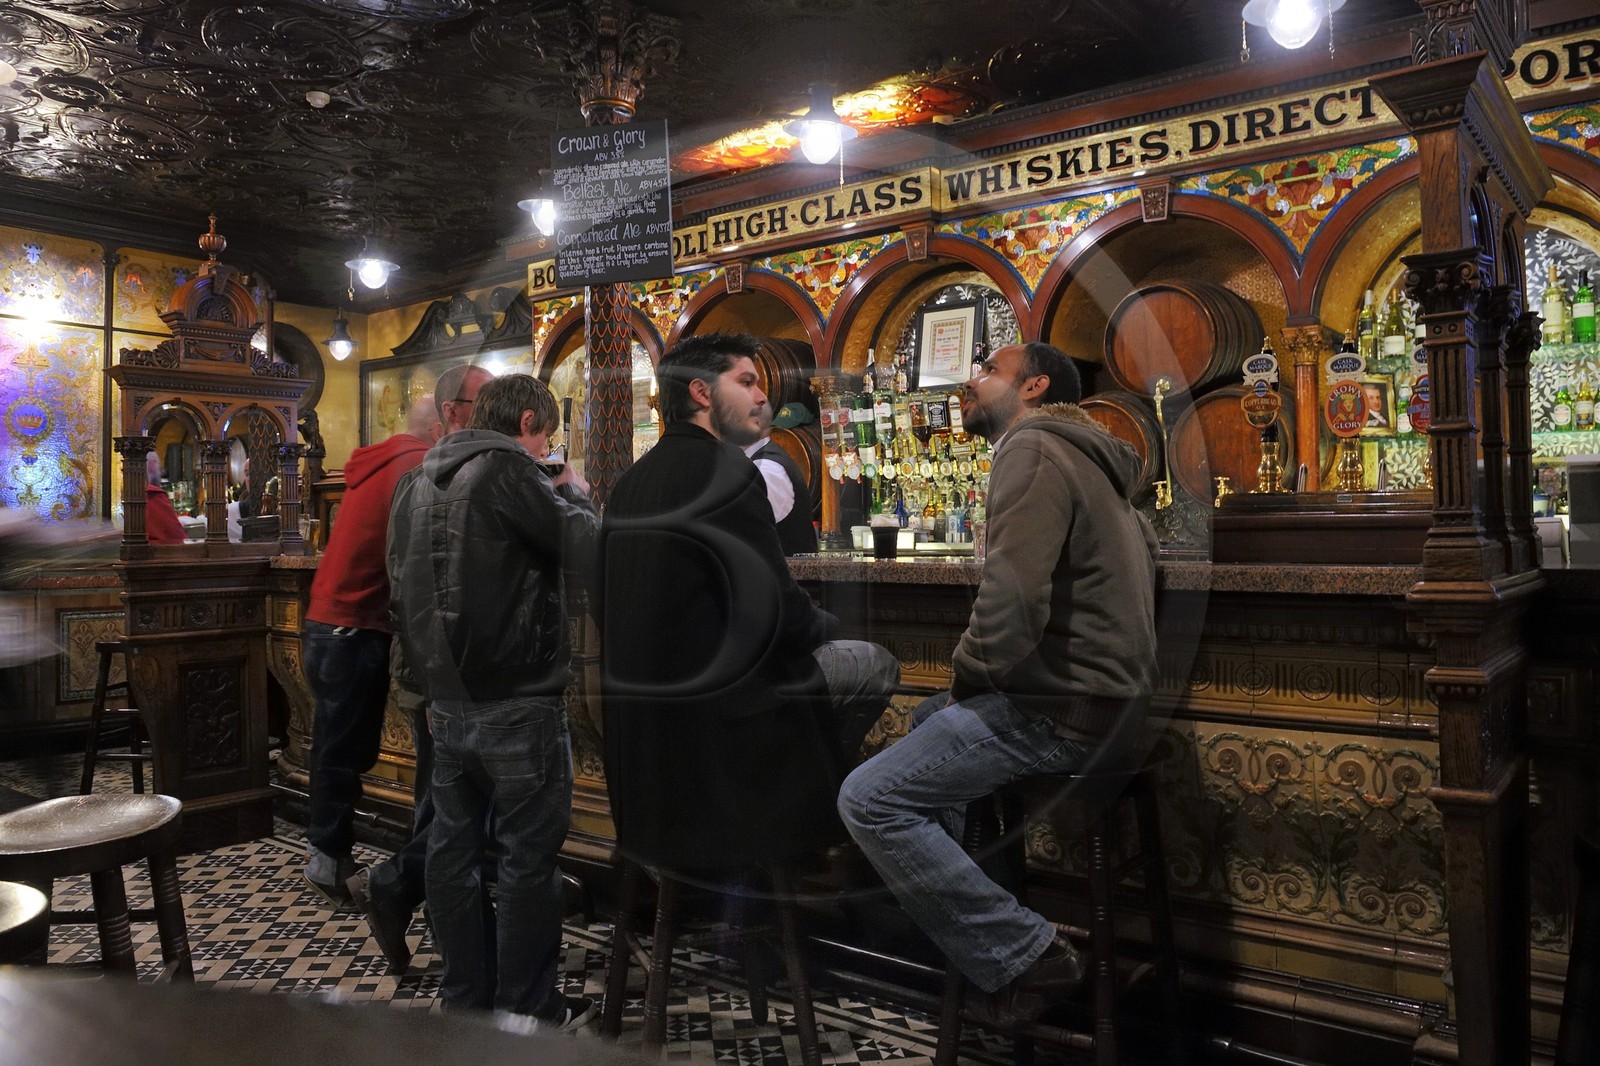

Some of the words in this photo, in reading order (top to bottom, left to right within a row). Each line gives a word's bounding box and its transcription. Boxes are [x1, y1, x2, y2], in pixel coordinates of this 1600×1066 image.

[1189, 86, 1376, 153] DIRECT
[558, 135, 601, 154] Crown
[603, 134, 609, 147] &
[613, 130, 646, 152] Glory
[594, 152, 608, 162] ABV
[562, 181, 608, 201] Belfast
[614, 180, 632, 197] Ale
[557, 224, 618, 249] Copperhead
[623, 222, 641, 240] Ale
[1332, 362, 1359, 370] MARQUE
[1328, 385, 1363, 402] CROWN
[1333, 421, 1361, 429] GLORY
